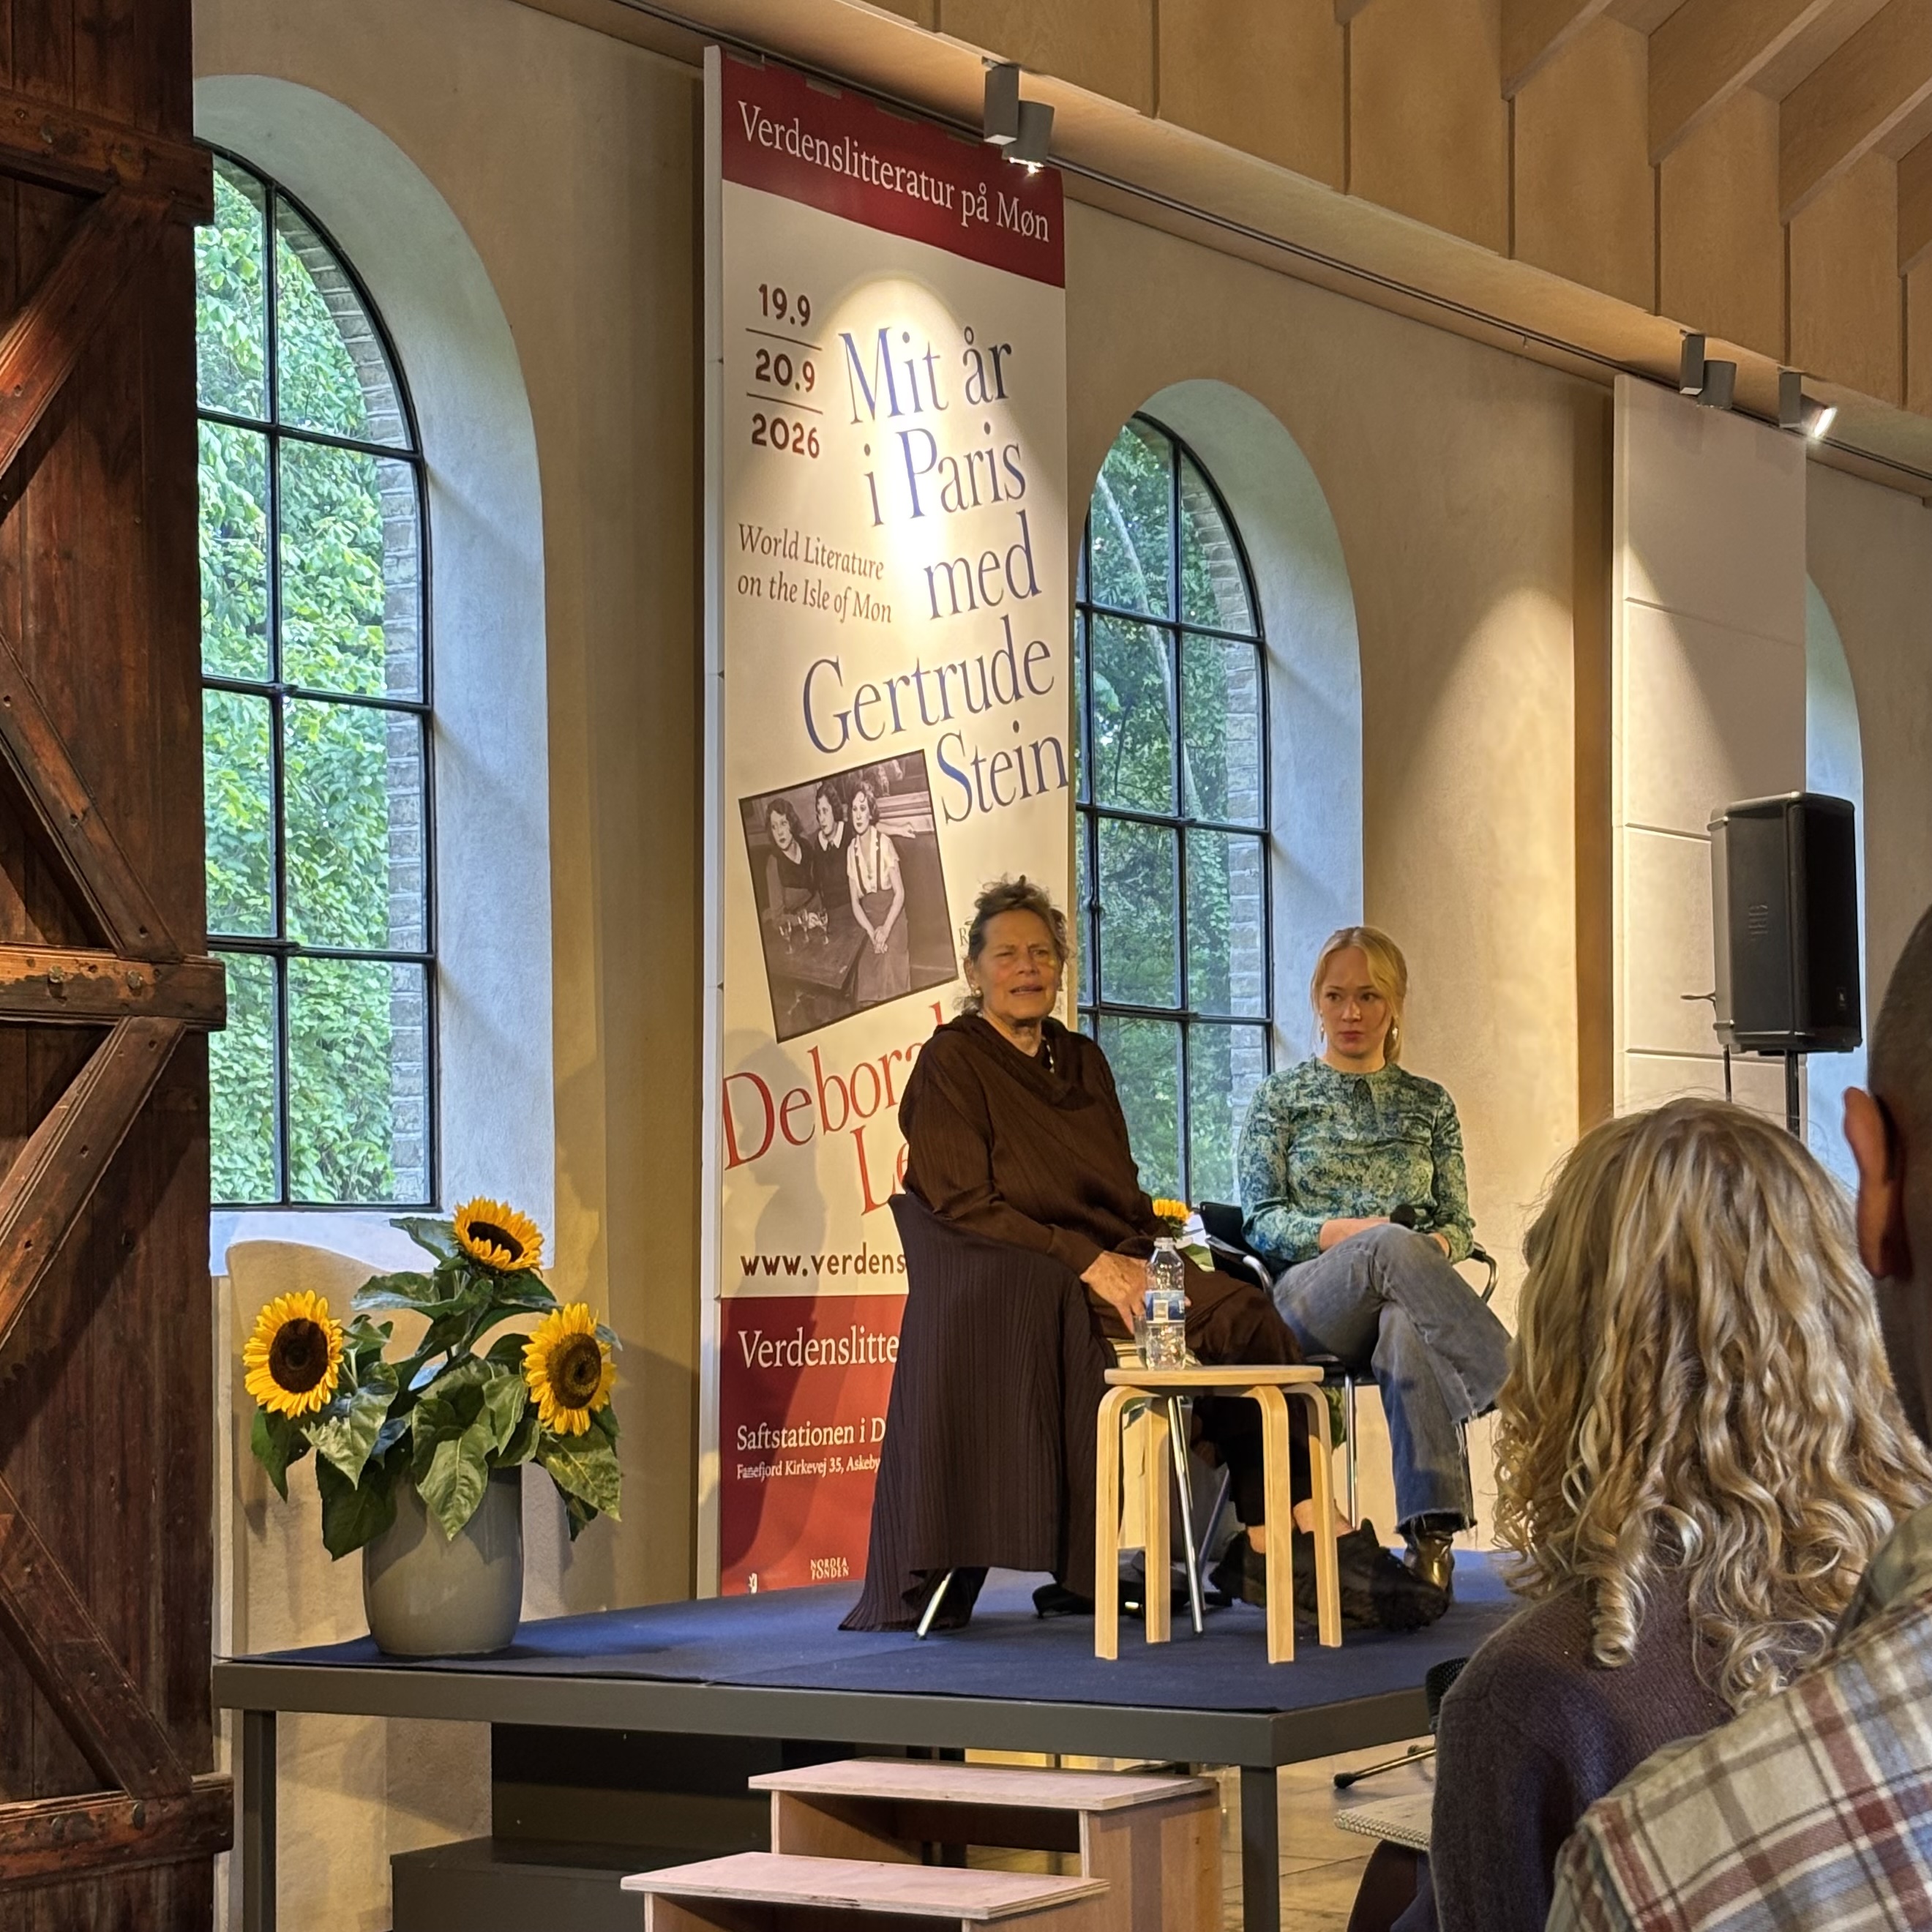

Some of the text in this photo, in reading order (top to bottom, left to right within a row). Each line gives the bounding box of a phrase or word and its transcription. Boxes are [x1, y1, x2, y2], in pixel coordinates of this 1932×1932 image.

[738, 100, 1049, 242] Verdenslitteratur på Møn
[758, 283, 811, 327] 19.9
[755, 349, 815, 392] 20.9
[838, 326, 1011, 424] Mit år
[752, 413, 820, 459] 2026
[863, 422, 1026, 527] i Paris
[738, 523, 884, 580] World Literature
[924, 509, 1041, 621] med
[737, 573, 763, 597] on
[769, 570, 798, 602] the
[802, 579, 829, 611] Isle
[833, 586, 853, 624] of
[803, 614, 1055, 754] Gertrude
[936, 719, 1068, 825] Stein
[723, 1000, 942, 1170] Debor
[740, 1242, 905, 1277] www.verdens
[738, 1325, 899, 1368] Verdenslitte
[737, 1418, 886, 1450] Saftstationen i D
[785, 1458, 826, 1478] Kirkevej
[829, 1457, 844, 1474] 35,
